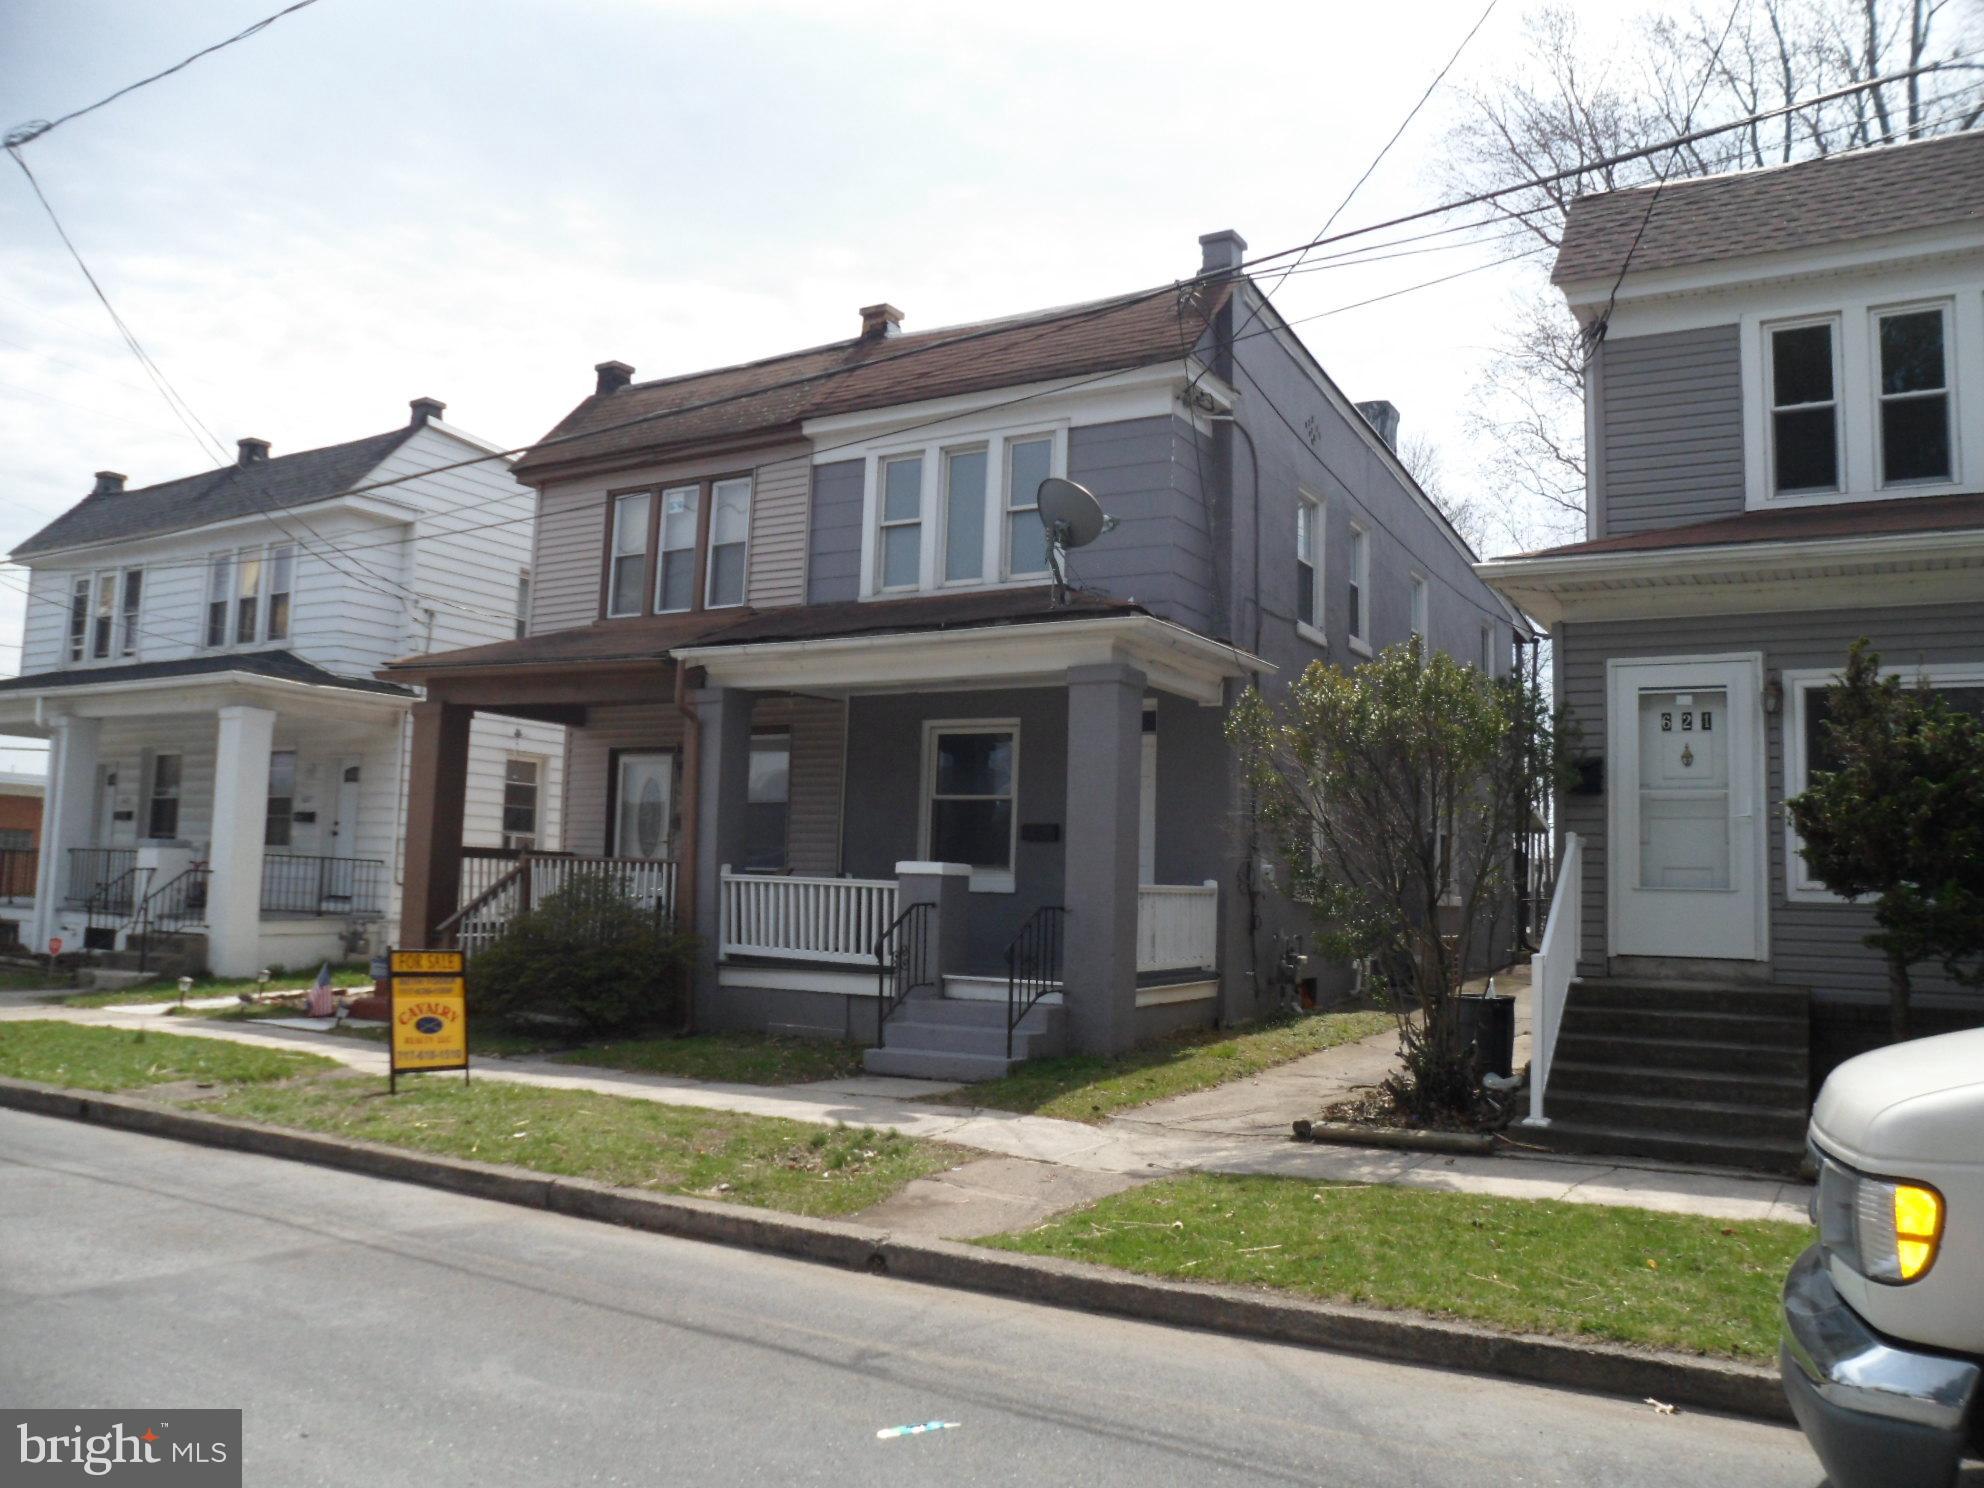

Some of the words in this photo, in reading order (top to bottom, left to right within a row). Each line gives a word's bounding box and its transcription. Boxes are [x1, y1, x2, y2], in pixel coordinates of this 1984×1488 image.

[1662, 712, 1711, 730] 621
[400, 953, 422, 969] FOR
[427, 953, 455, 969] SALE
[399, 1002, 458, 1025] CAVALRY
